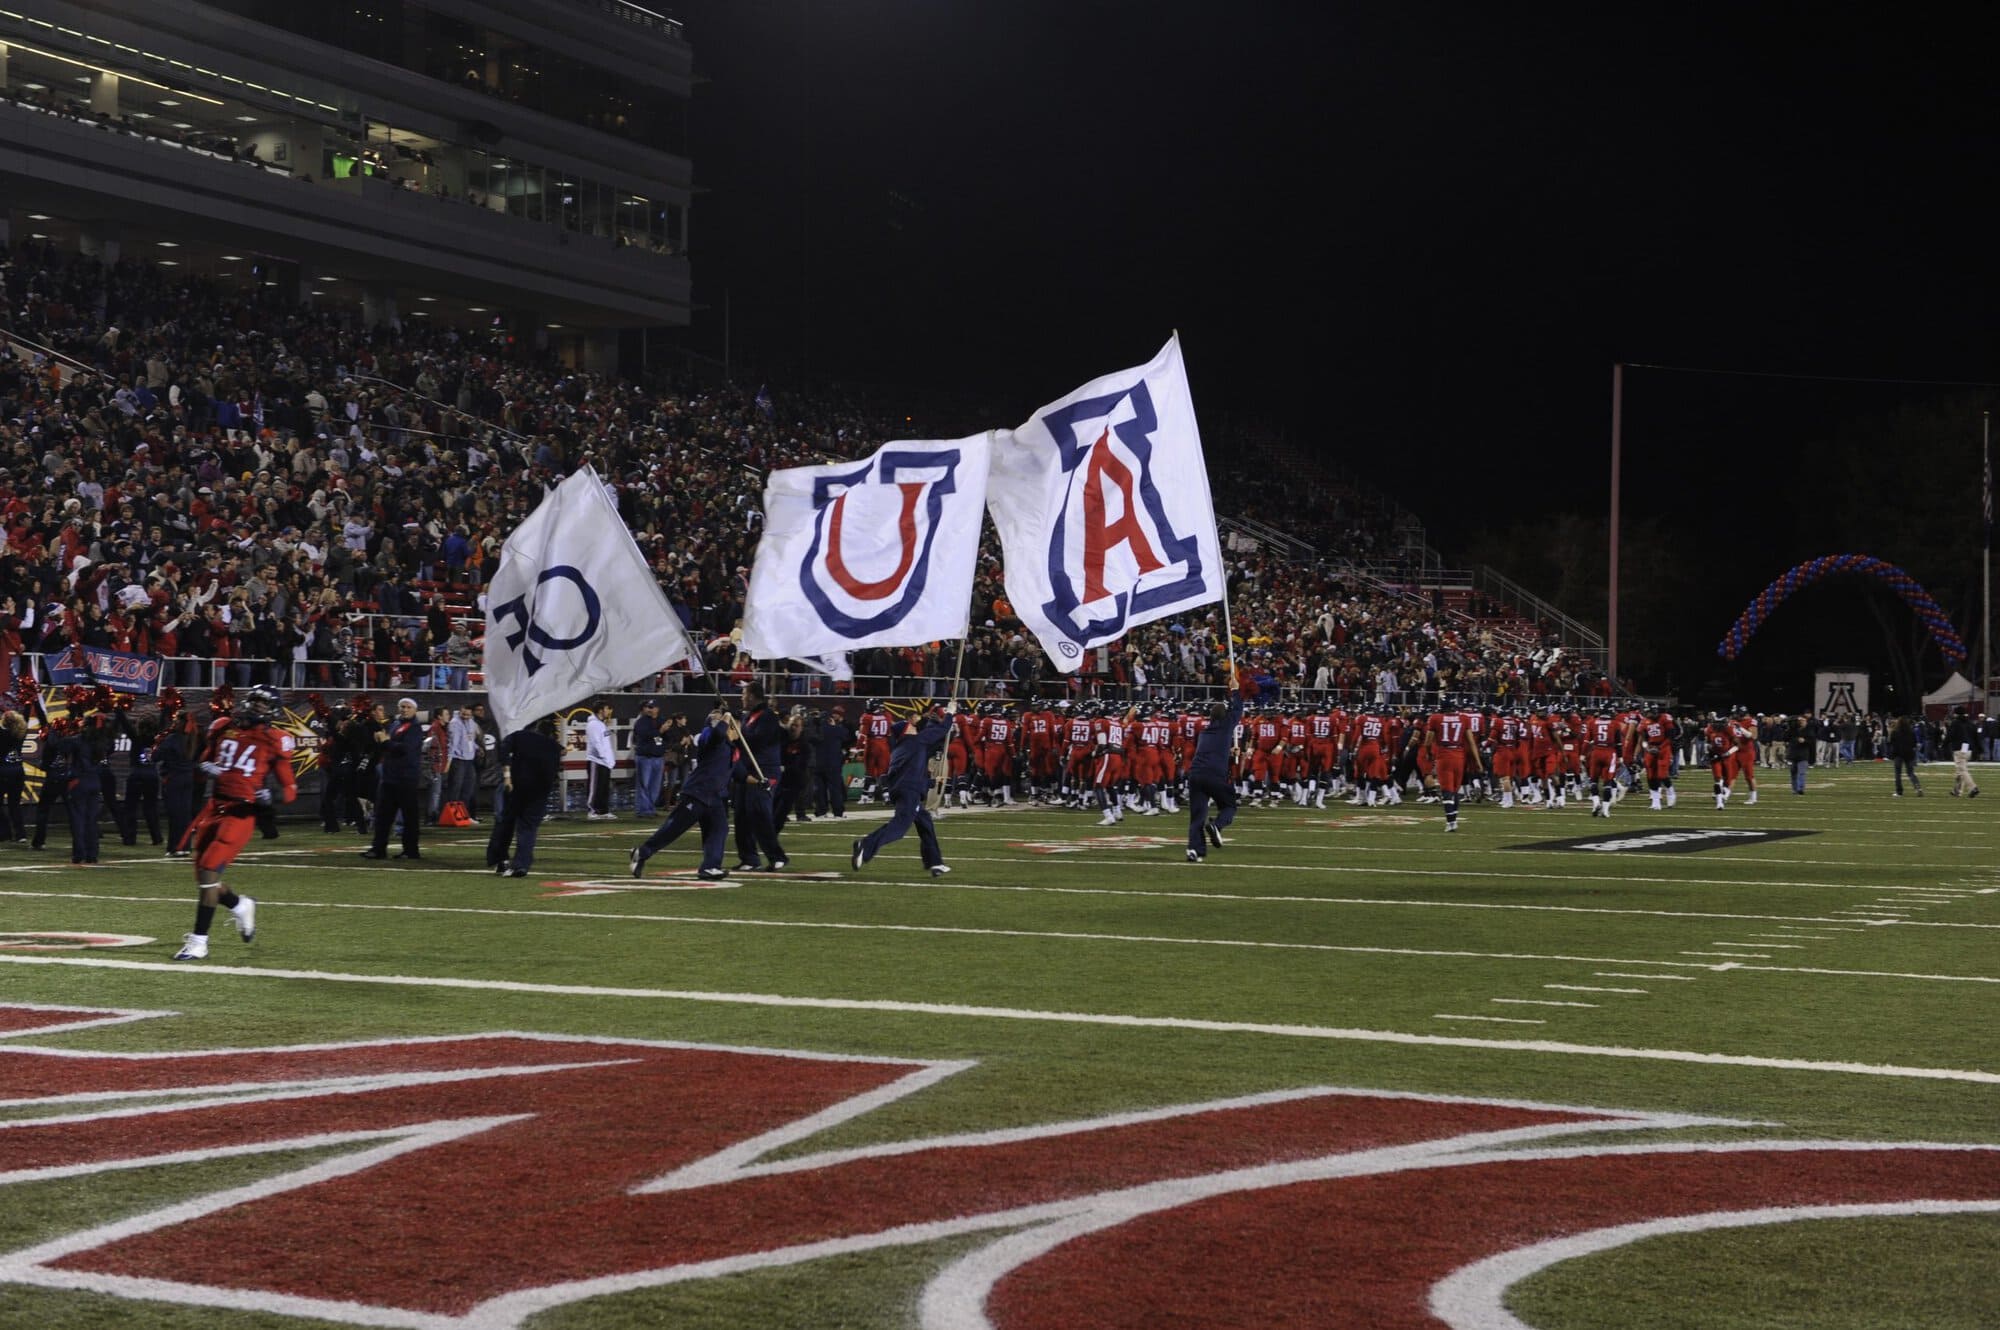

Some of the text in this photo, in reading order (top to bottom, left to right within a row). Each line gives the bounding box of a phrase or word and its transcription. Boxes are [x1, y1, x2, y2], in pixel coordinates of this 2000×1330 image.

[1042, 379, 1206, 648] A
[800, 449, 960, 640] U
[990, 724, 1007, 741] 59
[1072, 725, 1090, 742] 23
[1313, 720, 1330, 736] 16
[1363, 721, 1382, 737] 26
[1441, 722, 1462, 742] 17
[1597, 725, 1609, 742] 5
[218, 738, 256, 777] 84
